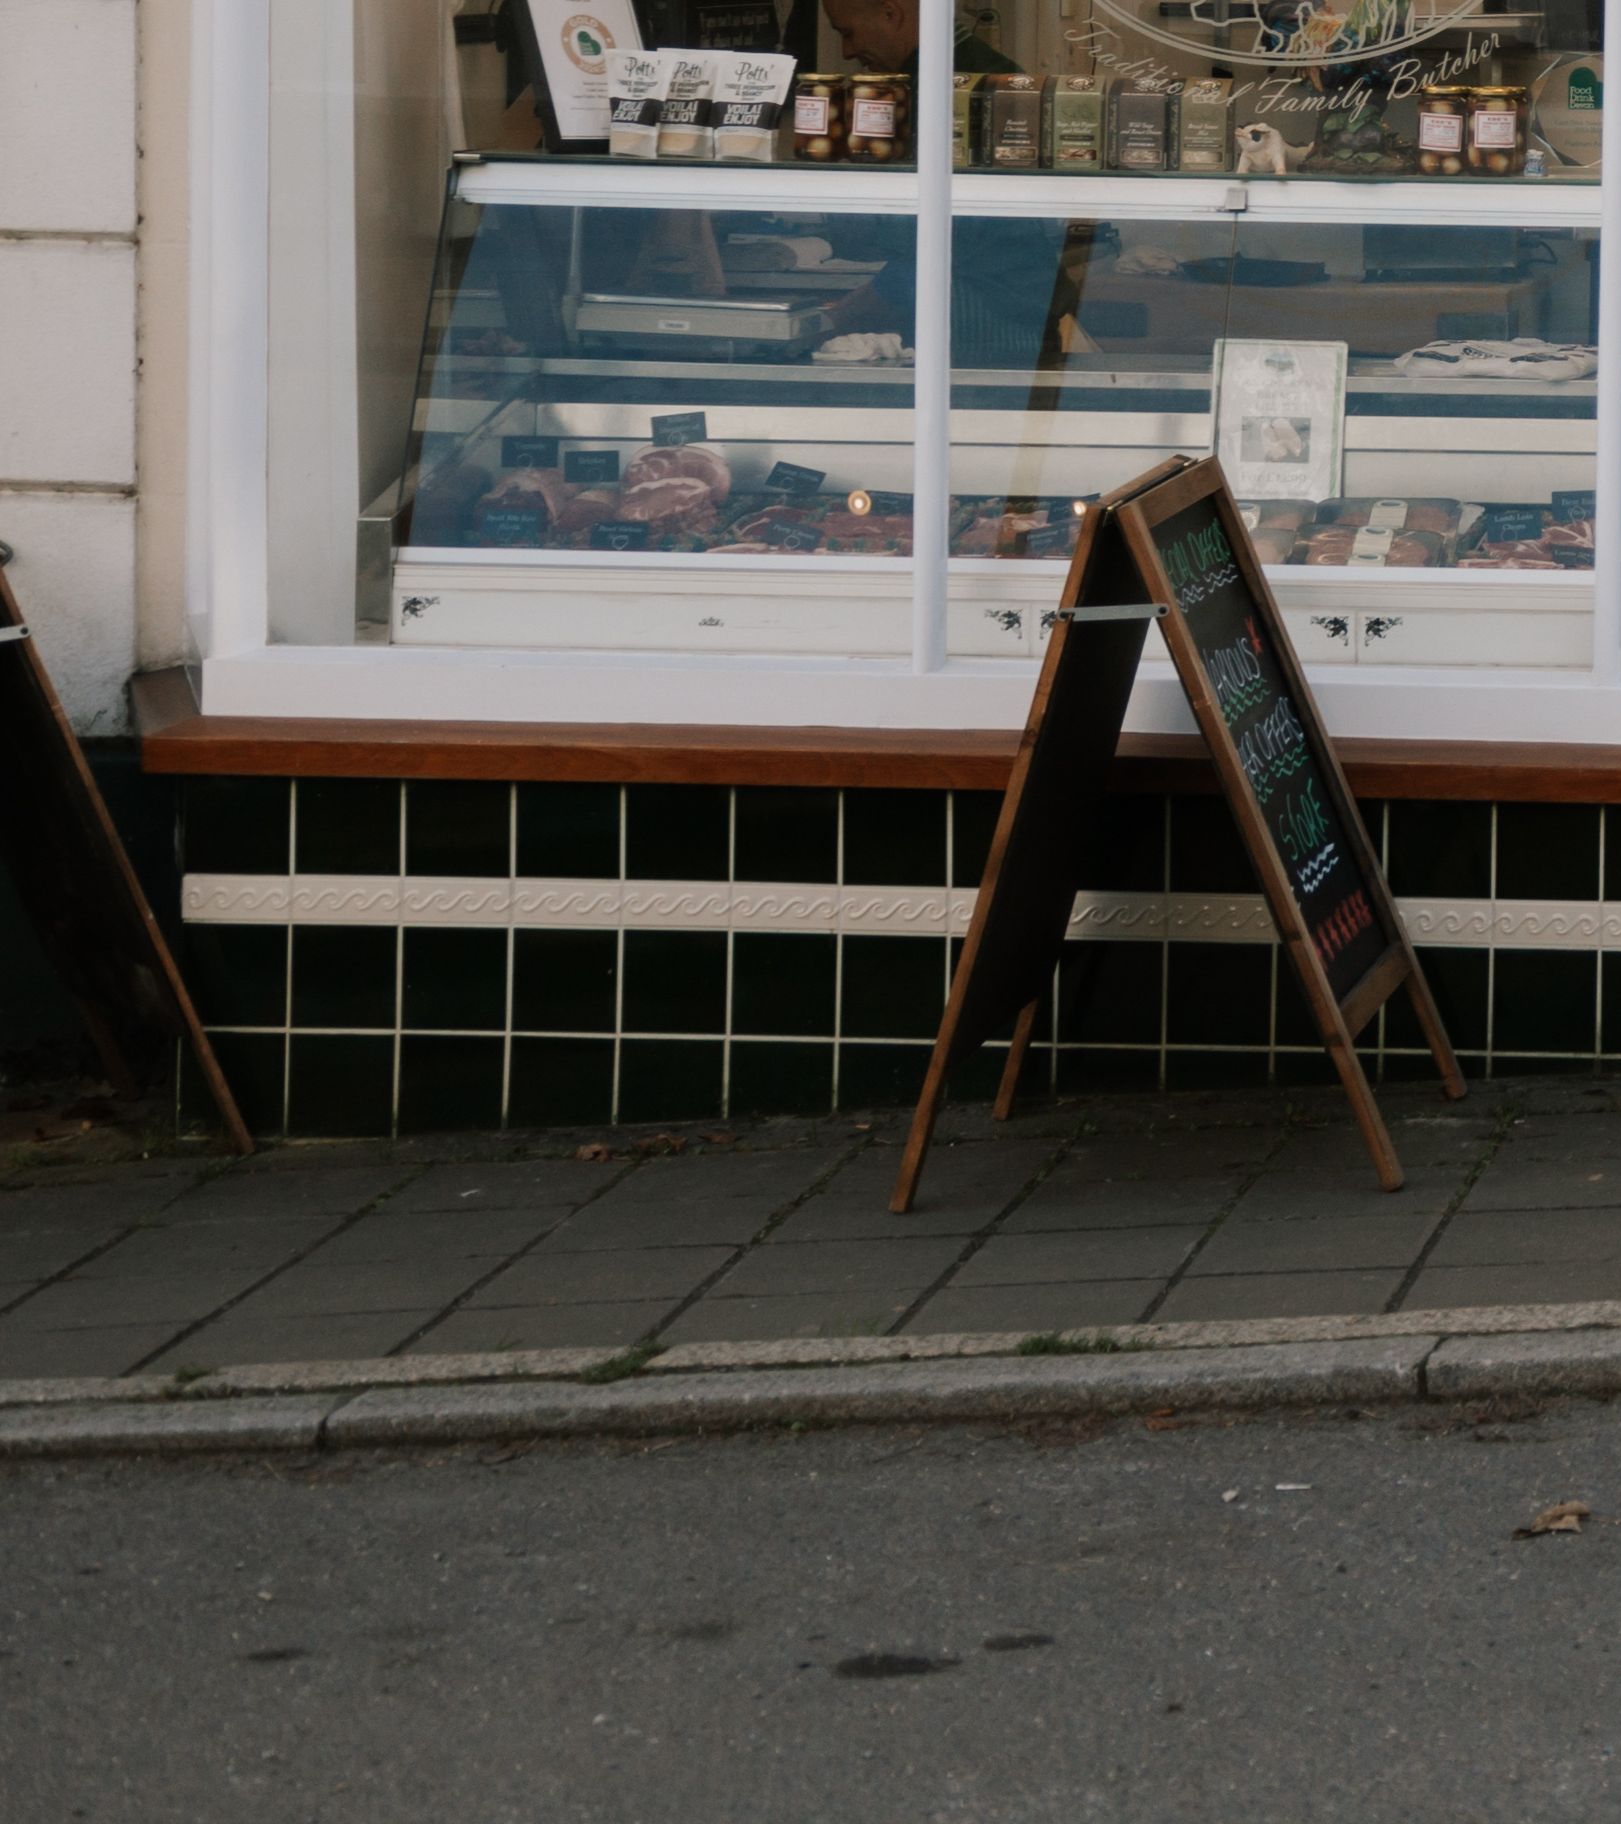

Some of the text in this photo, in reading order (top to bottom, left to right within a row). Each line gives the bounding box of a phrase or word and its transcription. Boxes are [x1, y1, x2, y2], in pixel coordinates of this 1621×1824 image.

[1065, 17, 1502, 123] Traditional Family Butcher
[1569, 86, 1592, 95] Food
[1569, 94, 1595, 103] Drink
[723, 114, 760, 125] ENJOY
[1254, 696, 1305, 762] OFFERS
[1278, 779, 1329, 862] STORE
